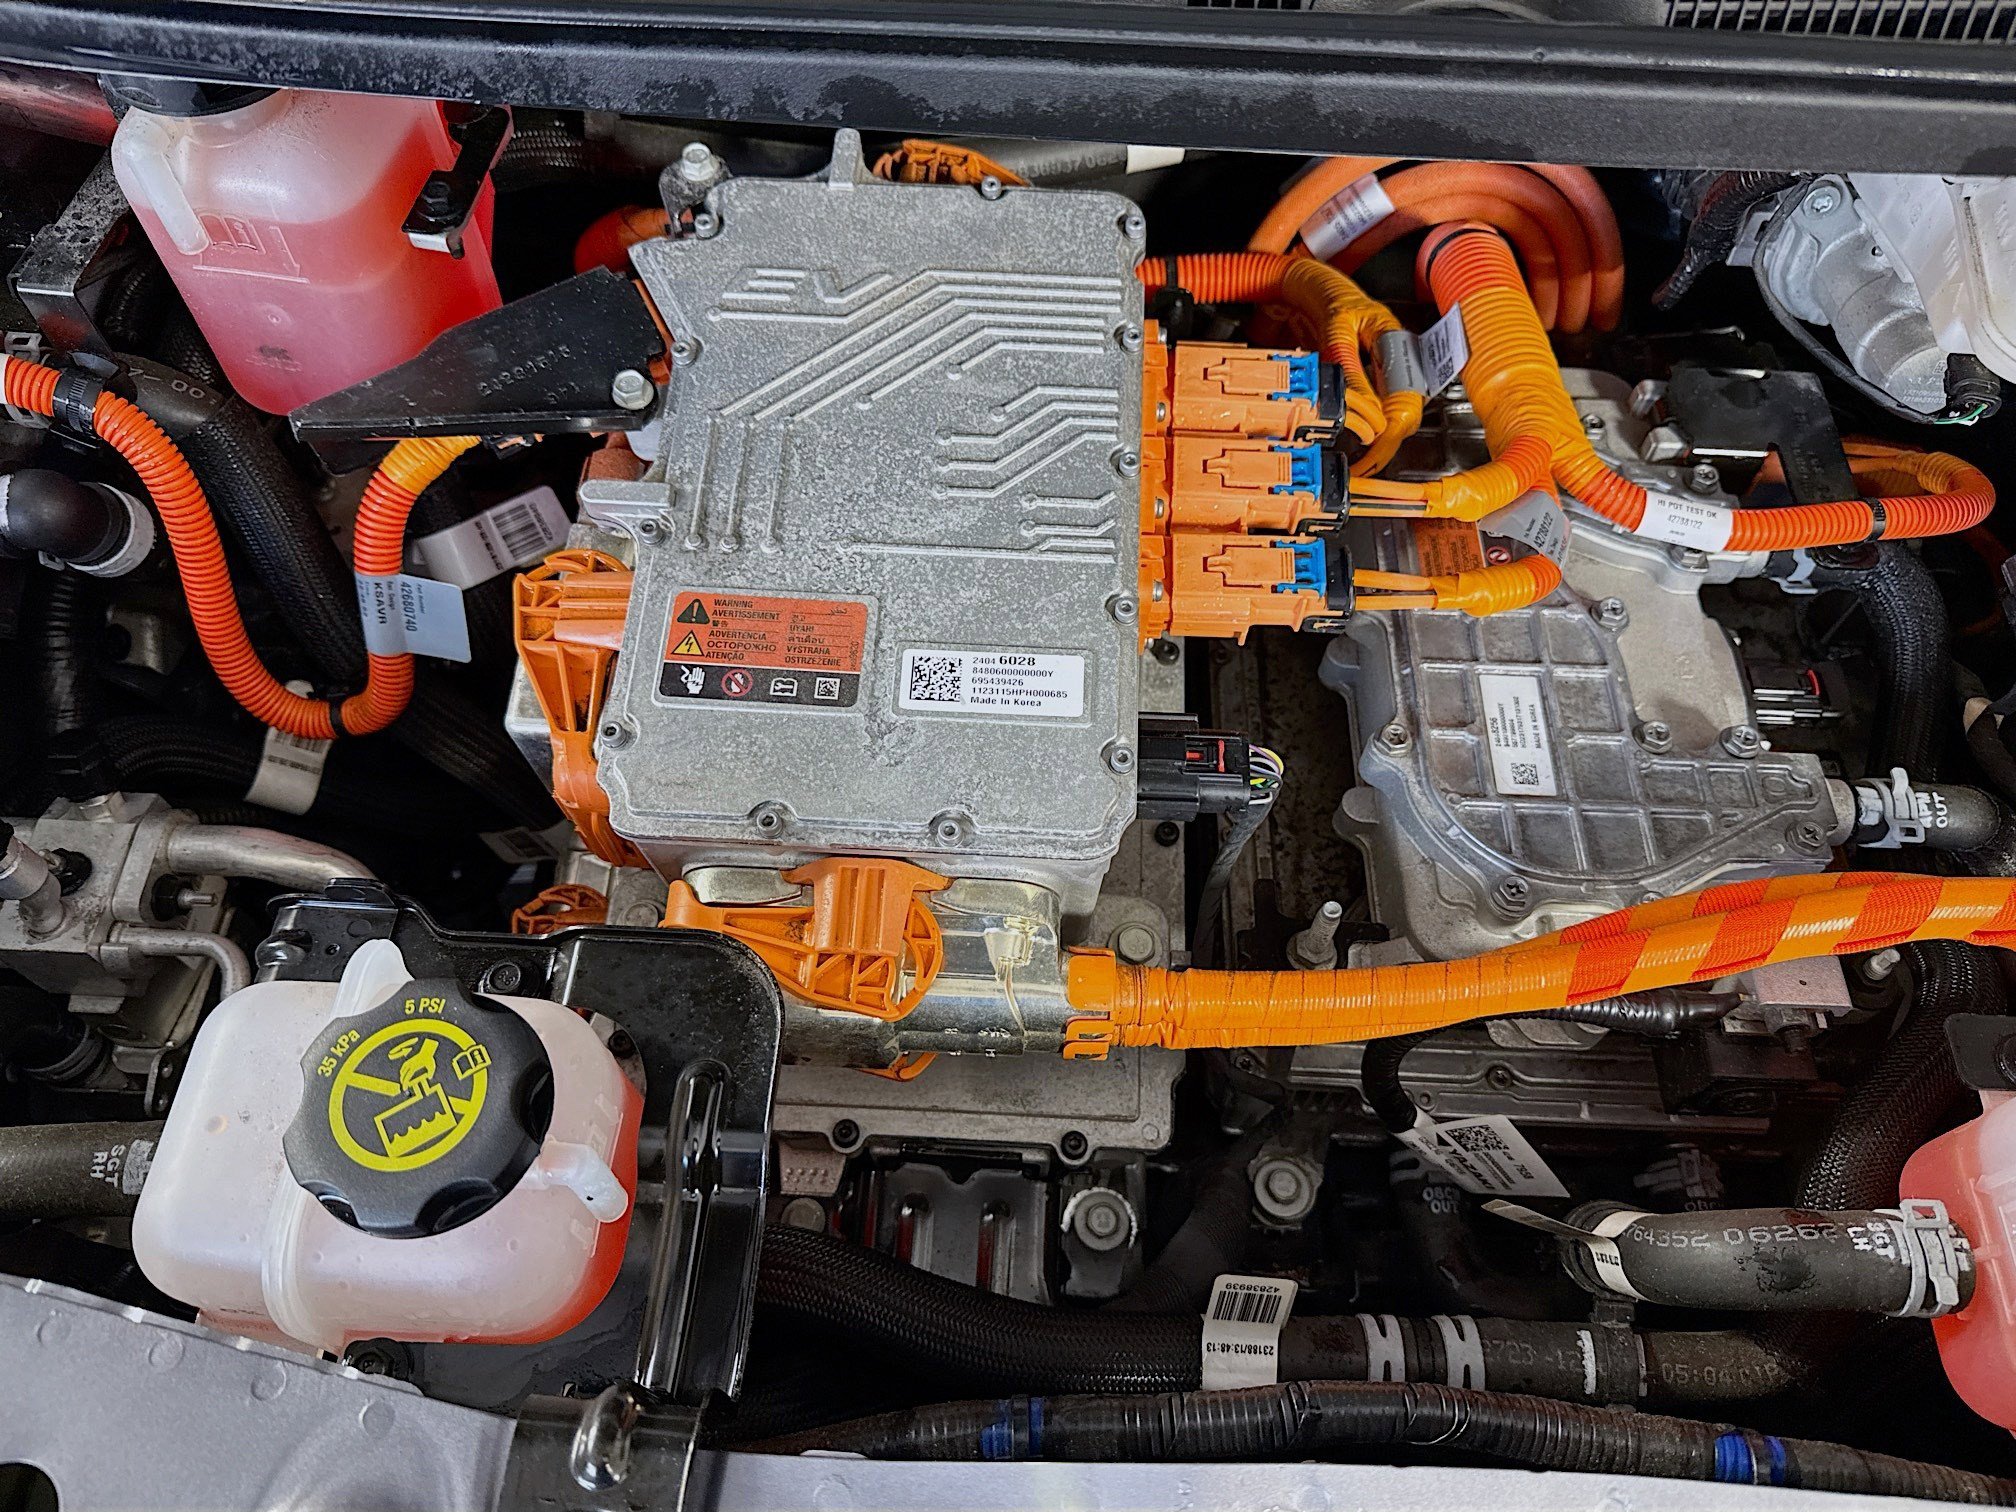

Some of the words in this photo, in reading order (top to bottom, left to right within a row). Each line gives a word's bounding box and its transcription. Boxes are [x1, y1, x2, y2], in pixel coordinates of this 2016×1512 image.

[1669, 501, 1683, 510] POT
[1686, 506, 1704, 515] TEST
[400, 581, 418, 632] 42680740
[714, 598, 753, 609] WARNING
[712, 608, 780, 620] AVERTISSEMENT
[709, 630, 767, 641] ADVERTENCIA
[707, 640, 776, 652] ОСТОРОЖНО
[705, 650, 744, 661] ATENÇÃO
[972, 656, 996, 665] 2404
[999, 655, 1036, 666] 6028
[972, 667, 1054, 677] 8480600000000Y
[971, 677, 1024, 687] 695439426
[970, 696, 997, 705] Made
[1013, 698, 1042, 707] Korea
[1529, 704, 1537, 722] KOREA
[1533, 732, 1541, 748] MADE
[1932, 791, 1948, 828] OUT
[405, 999, 415, 1015] 5
[419, 997, 446, 1013] PSI
[317, 1056, 337, 1077] 35
[330, 1030, 360, 1057] kPa
[90, 1151, 109, 1178] RH
[105, 1144, 126, 1187] SGT
[1450, 1149, 1496, 1190] YAZAKI
[1430, 1199, 1458, 1214] OUT
[1847, 1225, 1870, 1252] LH
[1225, 1283, 1280, 1293] 42838939
